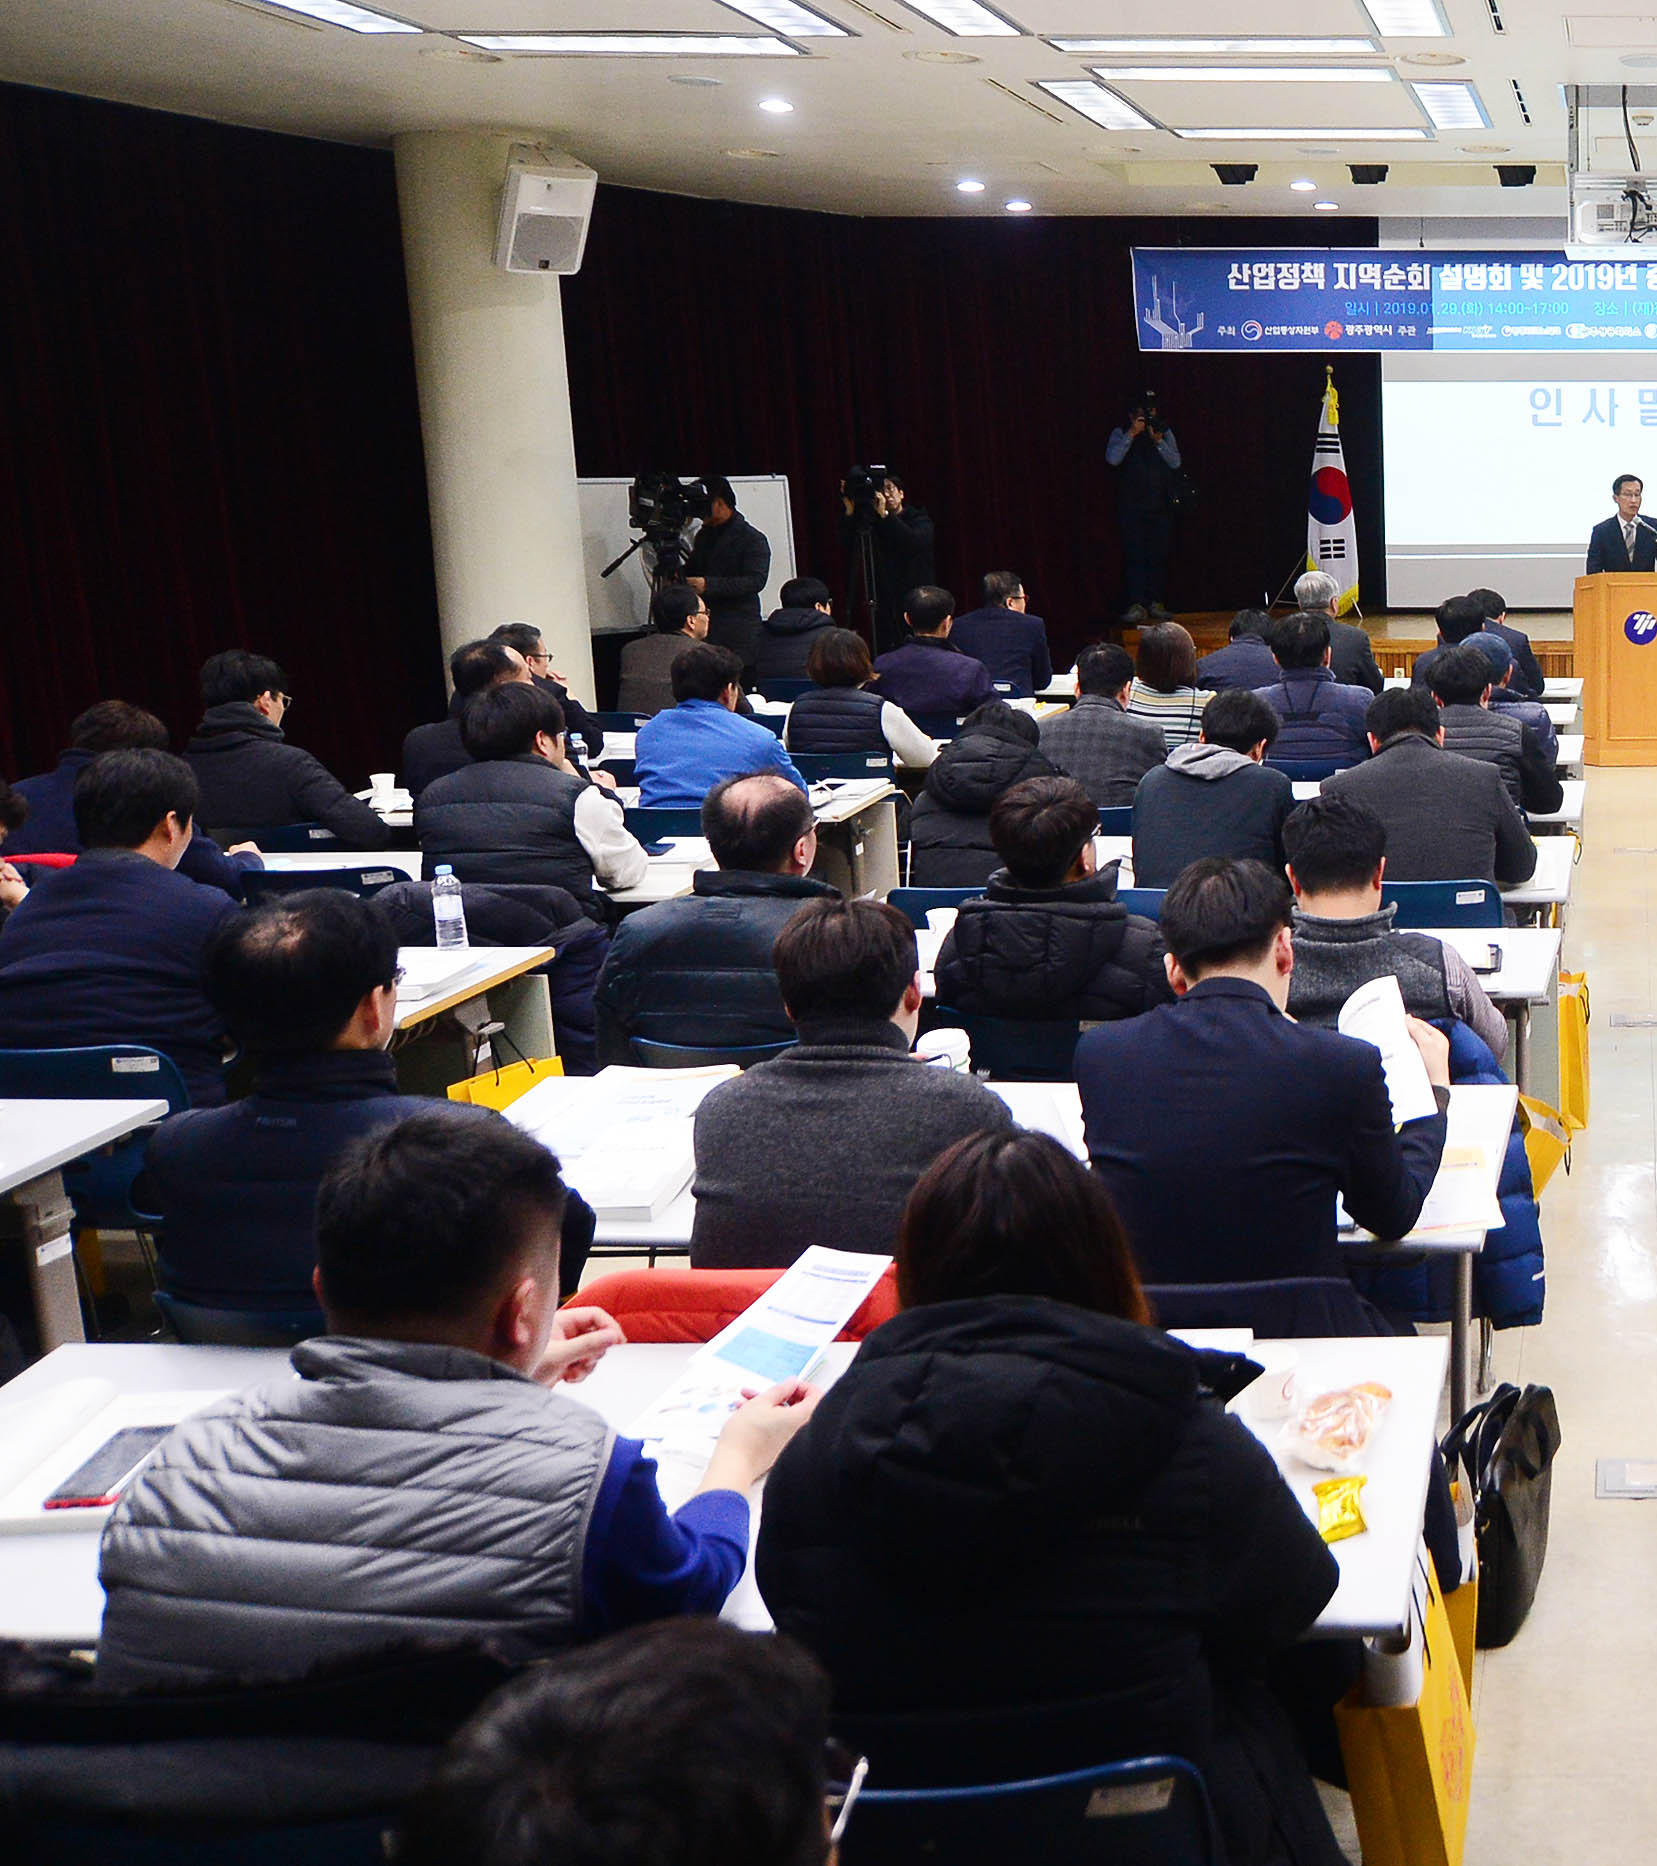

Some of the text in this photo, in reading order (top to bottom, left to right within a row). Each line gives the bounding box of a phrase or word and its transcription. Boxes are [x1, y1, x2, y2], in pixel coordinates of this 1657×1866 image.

[1227, 263, 1326, 291] 산업정책
[1333, 263, 1432, 291] 지역순회
[1439, 263, 1512, 291] 설명회
[1520, 263, 1544, 291] 및
[1552, 263, 1639, 291] 2019년
[1345, 302, 1369, 316] 일시
[1488, 302, 1569, 316] 14:00~17:00
[1594, 302, 1619, 316] 장소
[1217, 325, 1236, 337] 주최
[1345, 324, 1393, 336] 광주광역시
[1397, 325, 1417, 337] 주관
